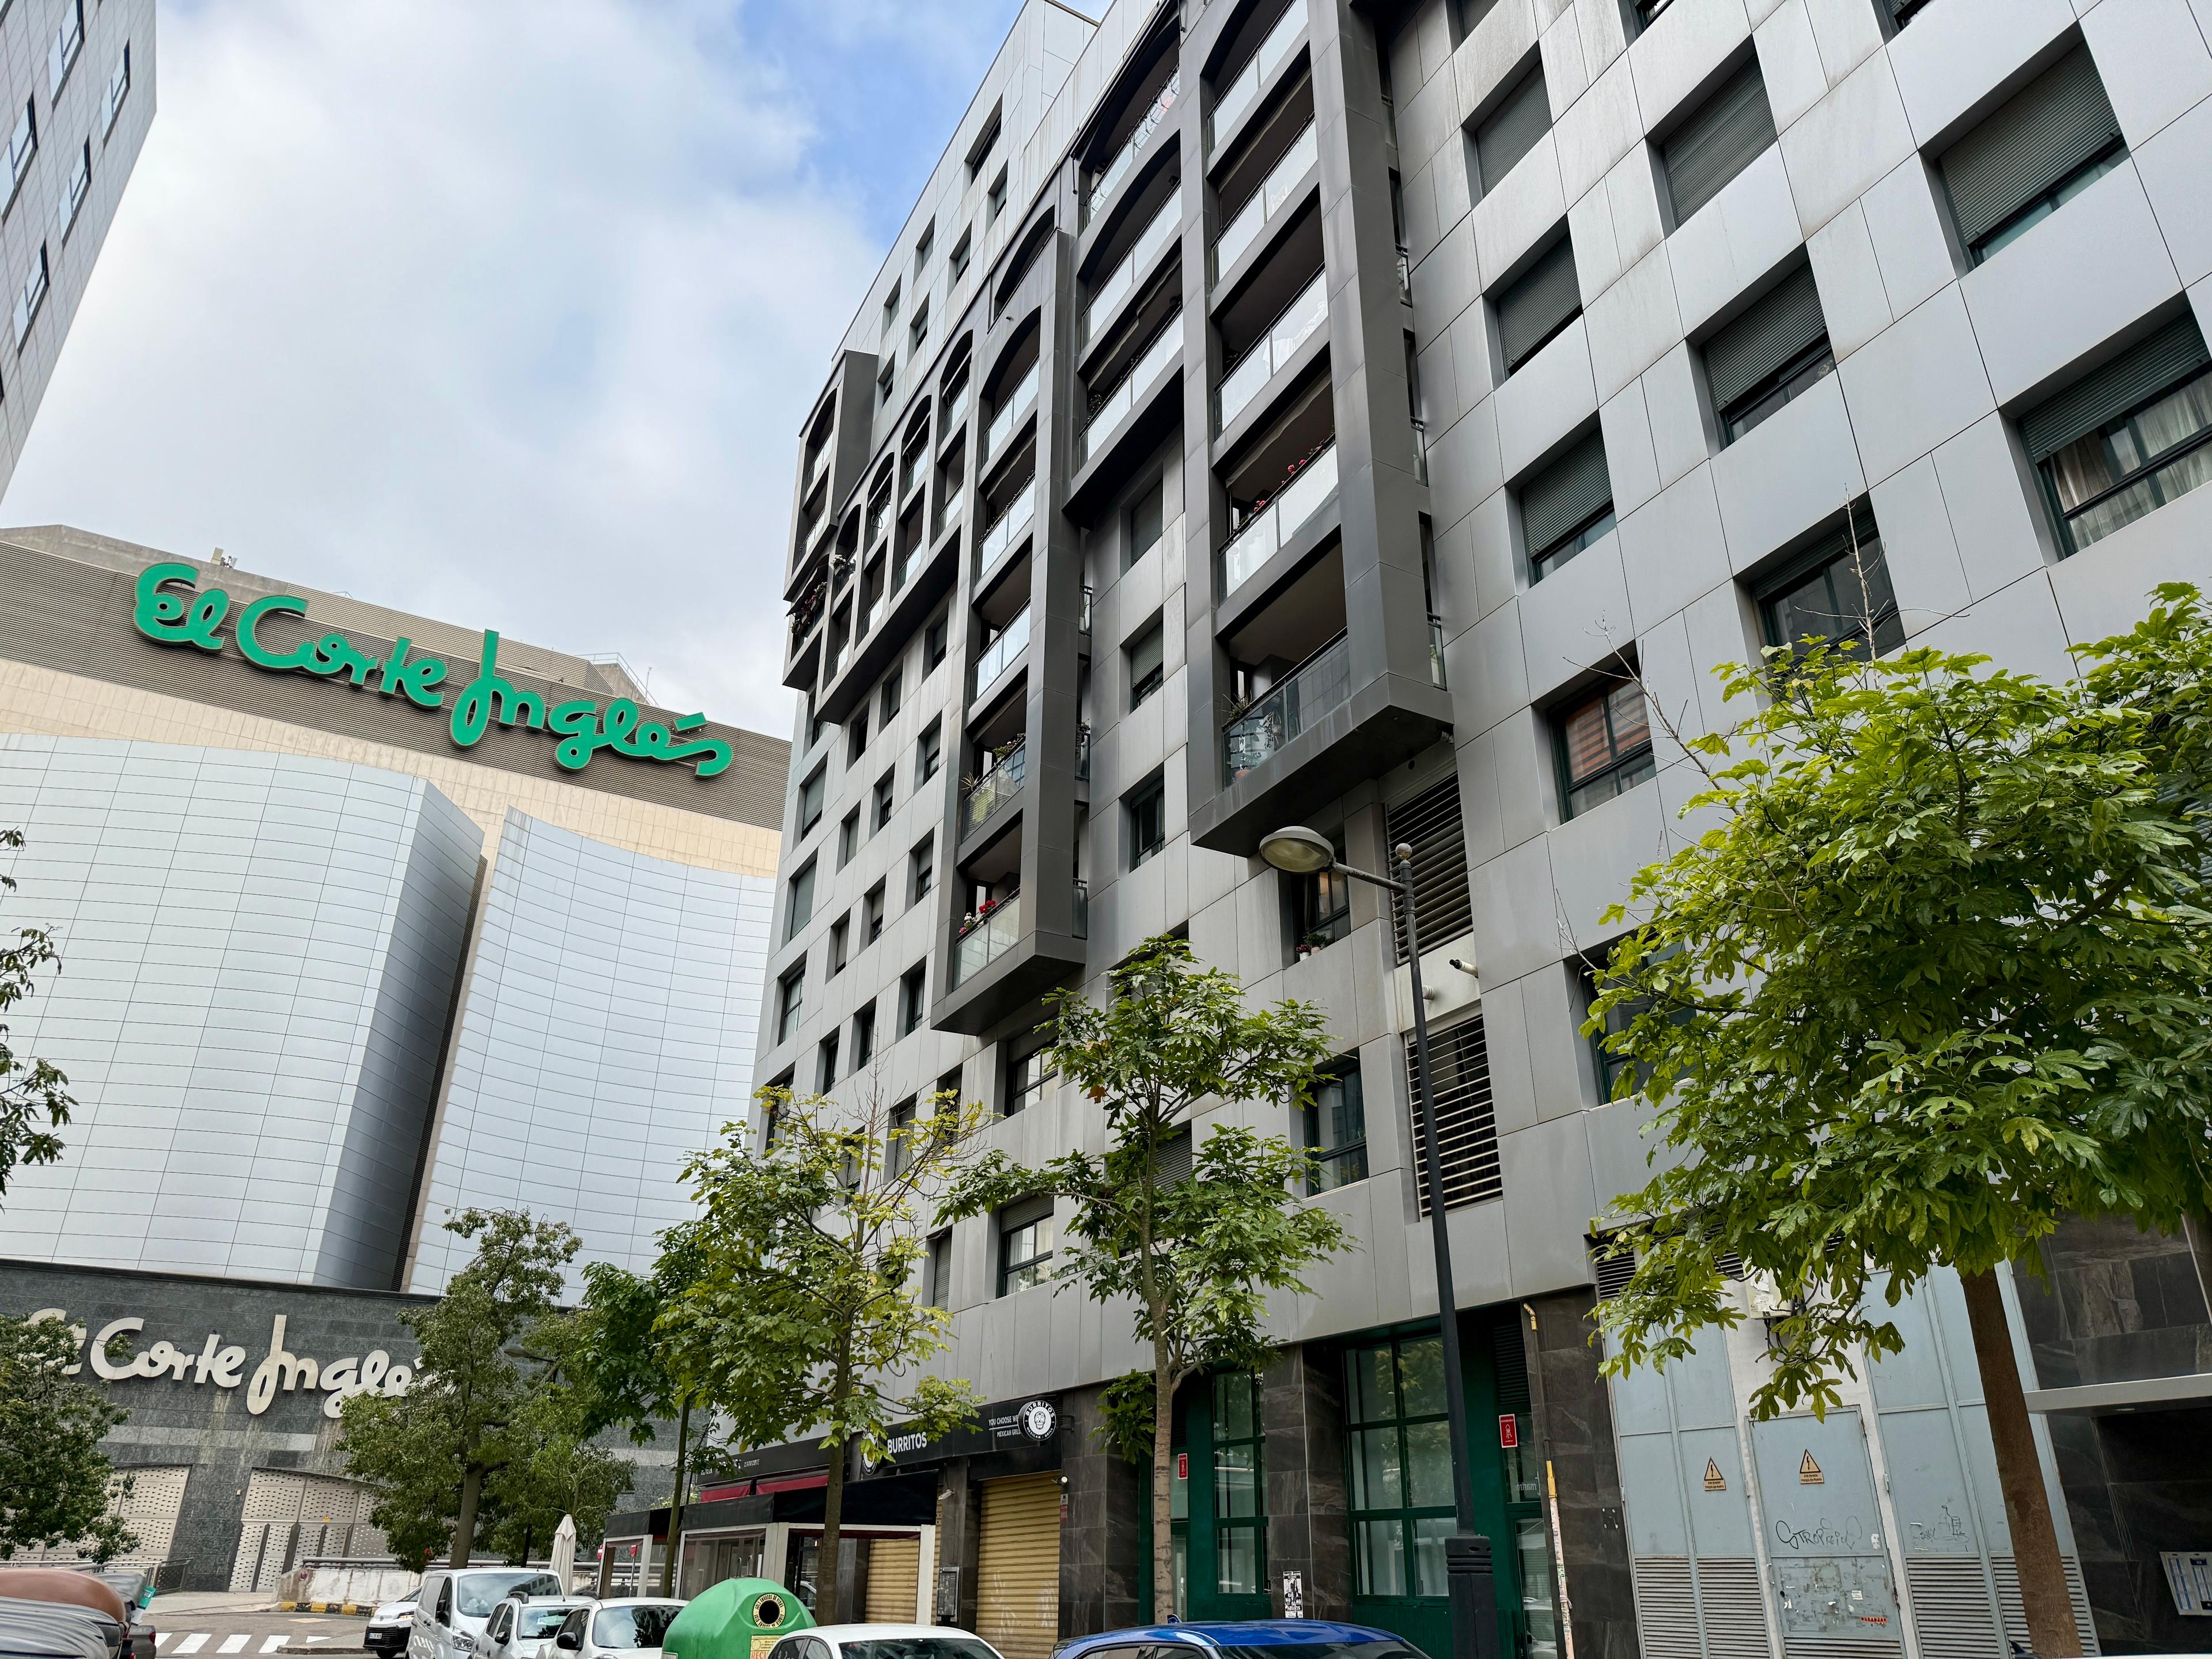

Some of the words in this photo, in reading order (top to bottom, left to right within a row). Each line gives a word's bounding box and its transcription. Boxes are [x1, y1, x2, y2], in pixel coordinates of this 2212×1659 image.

[134, 562, 231, 652] El
[236, 594, 448, 710] Corte
[450, 629, 733, 778] Inglés
[90, 1317, 246, 1388] Corte
[1025, 1402, 1055, 1418] BURRITOS
[997, 1415, 1012, 1425] CHOOSE
[997, 1429, 1012, 1437] MEXICAN
[1027, 1427, 1041, 1438] MEXICAN
[887, 1431, 927, 1454] BURRITOS
